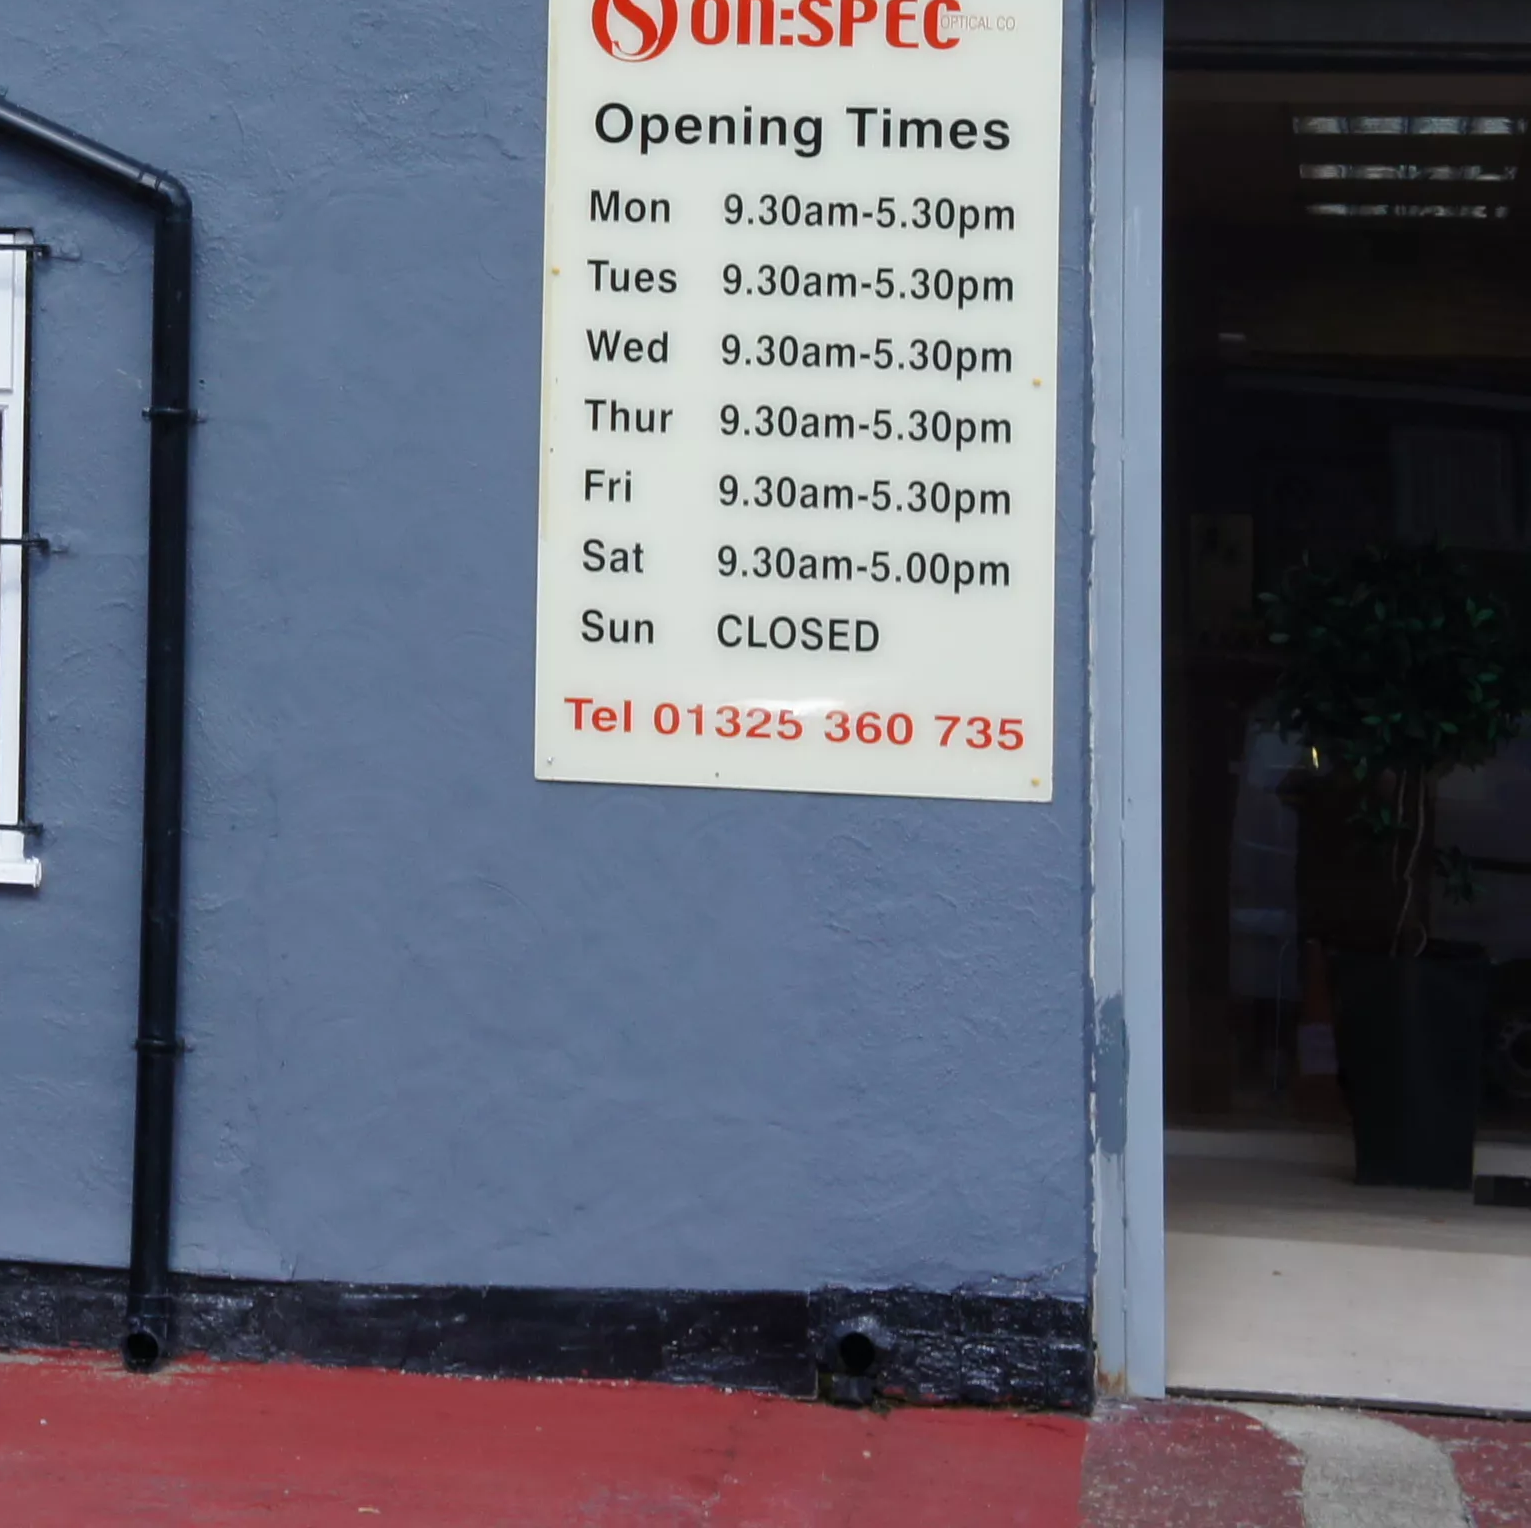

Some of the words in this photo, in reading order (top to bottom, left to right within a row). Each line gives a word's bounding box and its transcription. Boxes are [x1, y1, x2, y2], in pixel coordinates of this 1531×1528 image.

[940, 15, 992, 31] OPTICAL
[996, 16, 1016, 31] CO
[596, 103, 822, 157] Opening
[846, 108, 1009, 150] Times
[591, 190, 669, 222] Mon
[725, 194, 1014, 238] 9.30am-5.30pm
[588, 260, 676, 293] Tues
[723, 264, 1013, 309] 9.30am-5.30pm
[587, 330, 668, 362] Wed
[722, 334, 1011, 380] 9.30am-5.30pm
[585, 400, 672, 432] Thur
[721, 405, 1010, 451] 9.30am-5.30pm
[585, 470, 631, 501] Fri
[720, 475, 1010, 522] 9.30am-5.30pm
[583, 539, 643, 572] Sat
[718, 546, 1009, 593] 9.30am-5.00pm
[582, 610, 653, 643] Sun
[718, 615, 879, 651] CLOSED
[565, 698, 633, 732] Tel
[654, 703, 803, 740] 01325
[826, 712, 914, 745] 360
[936, 715, 1025, 751] 735
